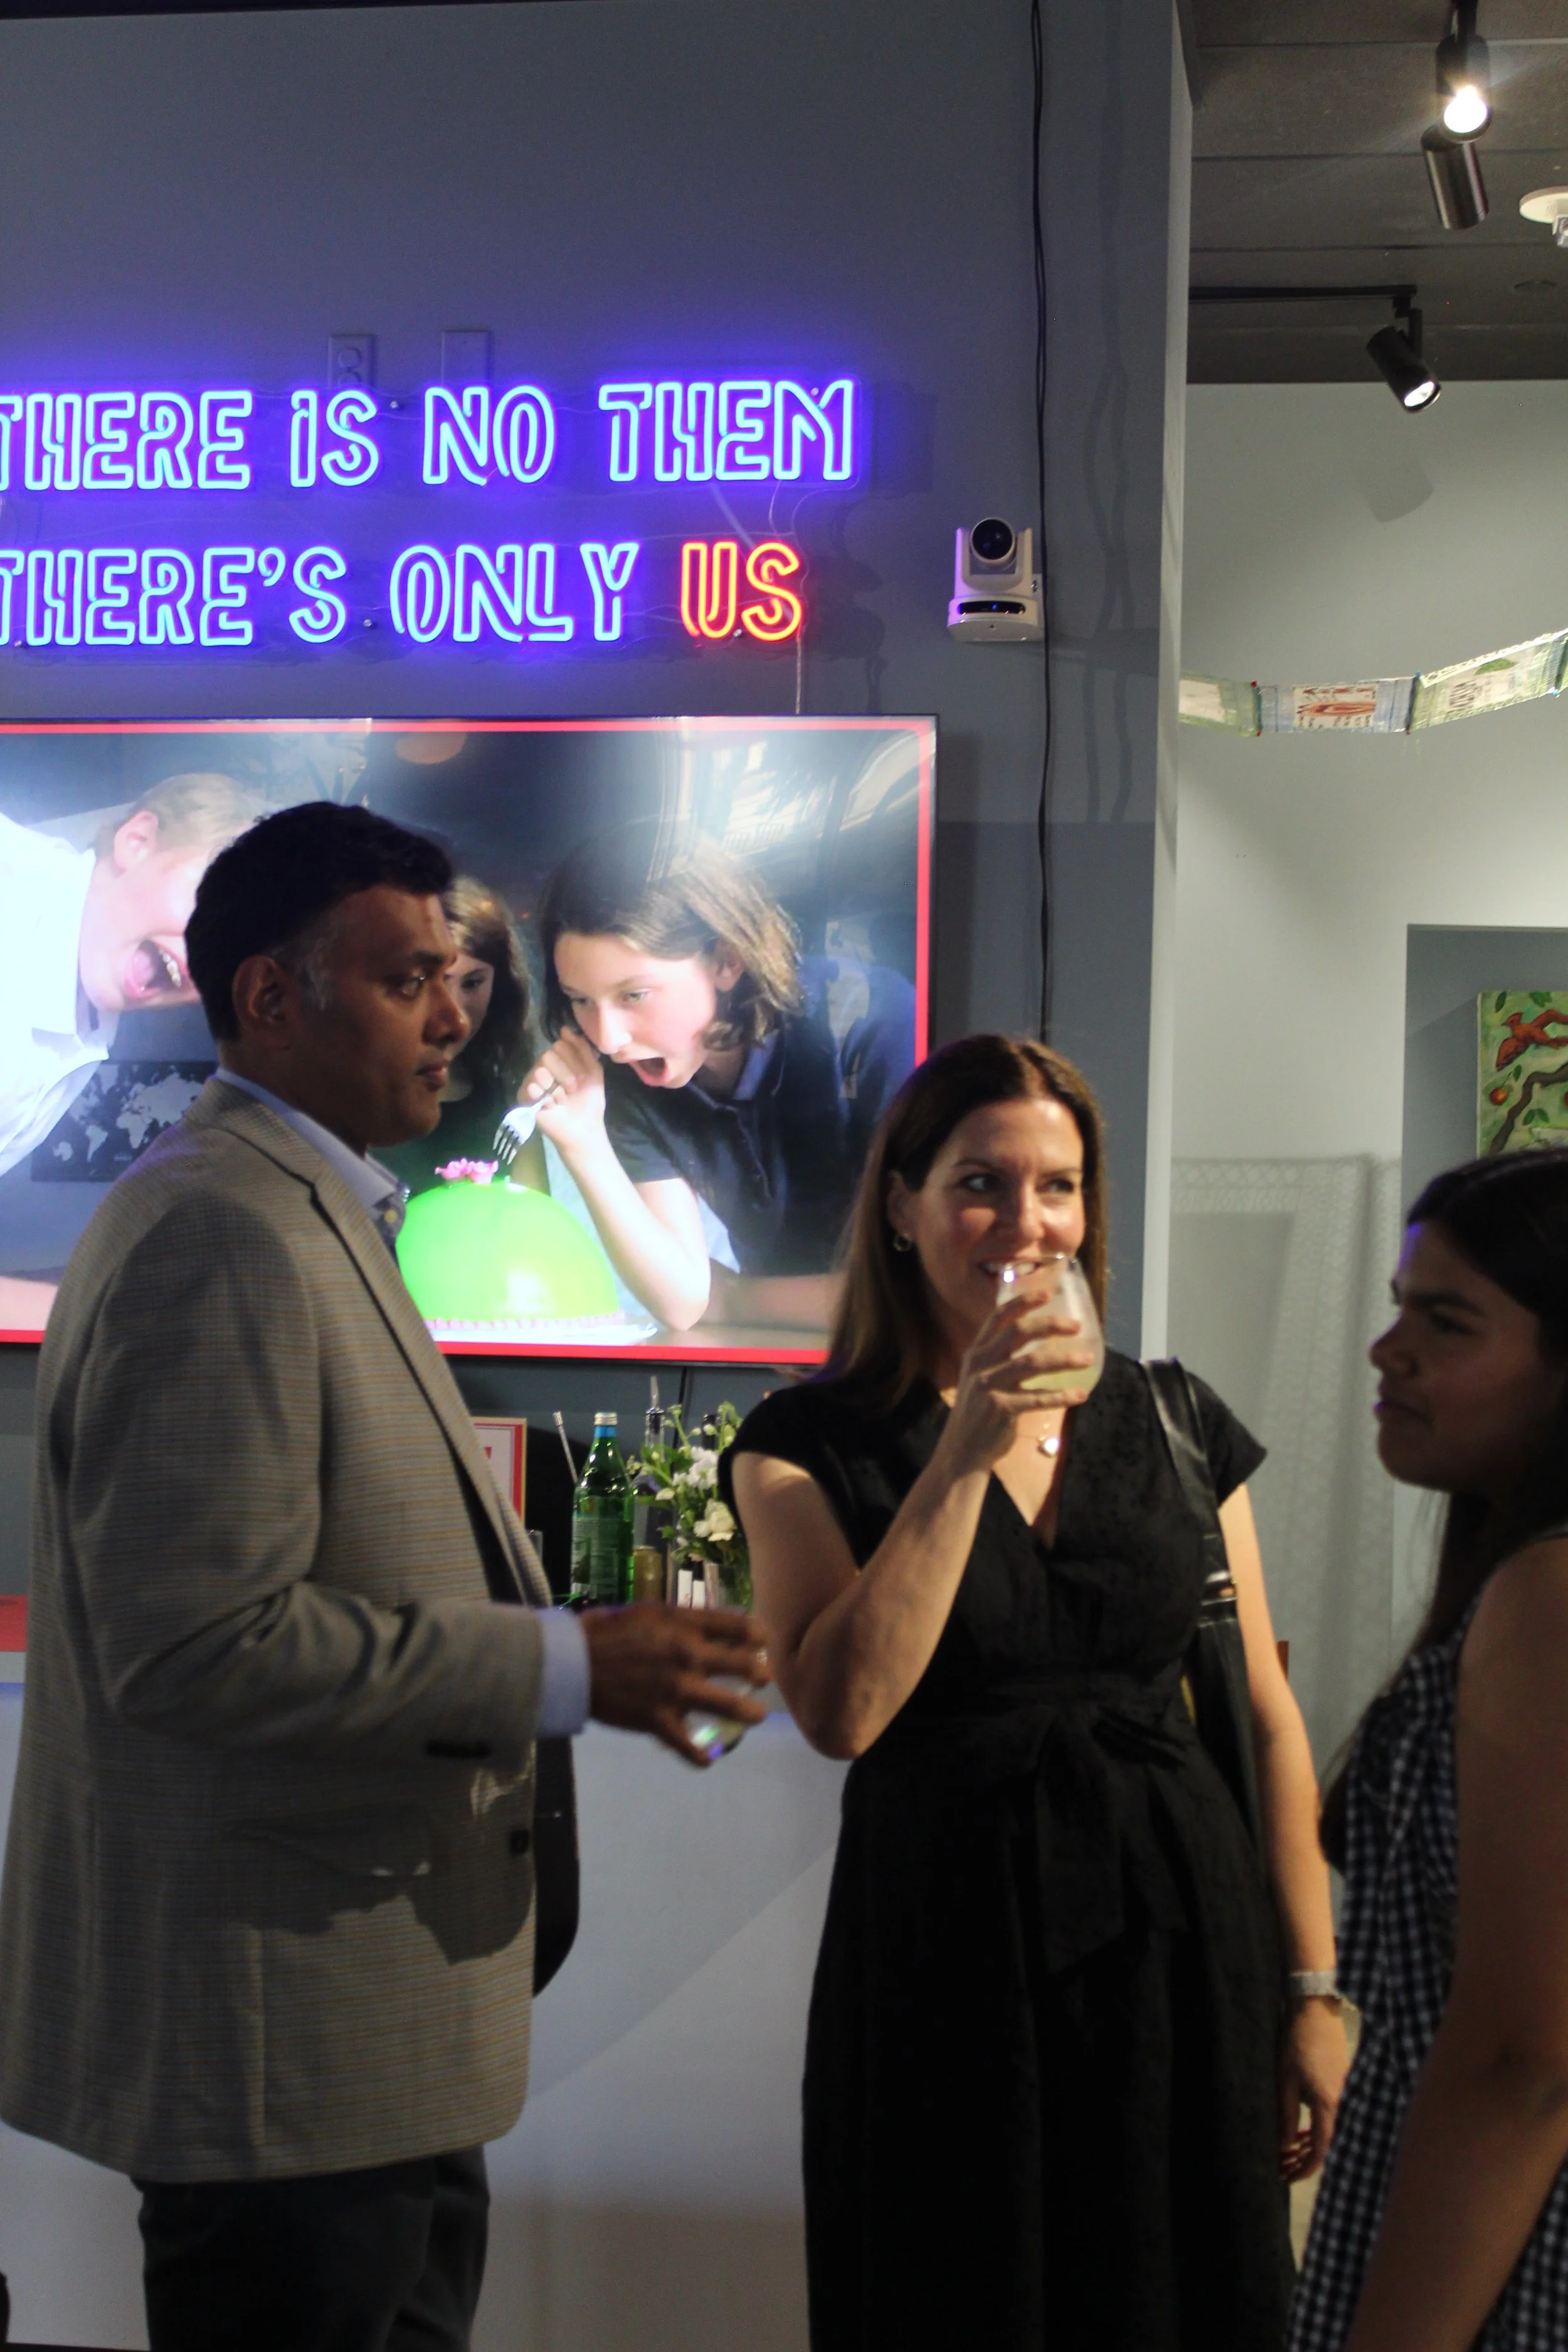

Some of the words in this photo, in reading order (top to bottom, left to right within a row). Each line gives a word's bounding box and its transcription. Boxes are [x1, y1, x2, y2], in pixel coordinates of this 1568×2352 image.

[290, 389, 378, 487] IS
[423, 384, 554, 486] NO
[598, 379, 853, 482] THEM
[389, 543, 639, 643] ONLY
[682, 541, 802, 642] US
